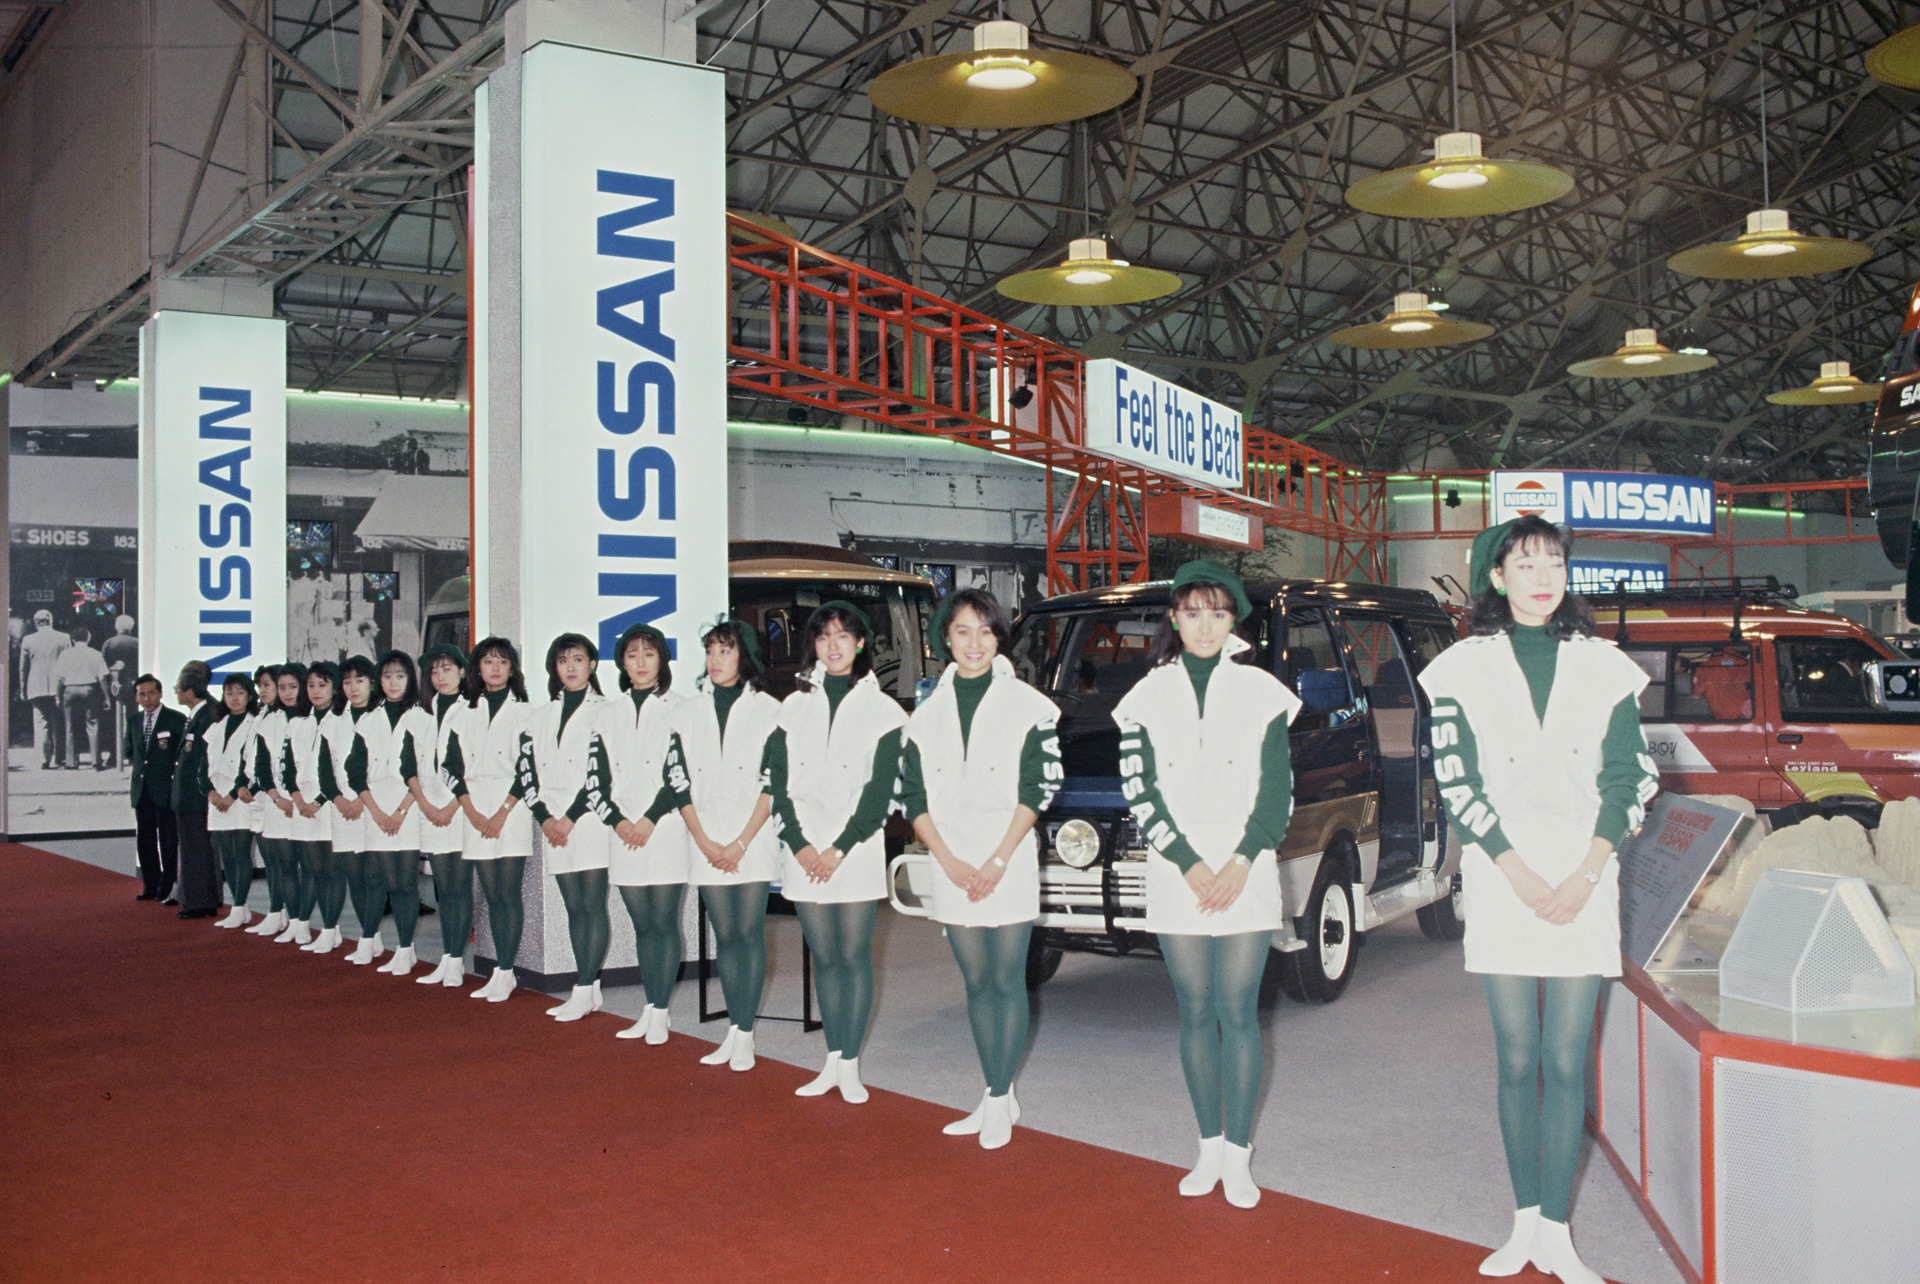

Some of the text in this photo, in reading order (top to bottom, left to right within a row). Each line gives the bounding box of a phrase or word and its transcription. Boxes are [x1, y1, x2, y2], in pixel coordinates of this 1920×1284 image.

[596, 168, 678, 661] NISSAN
[1115, 365, 1240, 482] Feel the Beat
[27, 528, 90, 546] SHOES
[114, 535, 137, 549] 182
[198, 385, 252, 686] NISSAN
[1504, 492, 1557, 506] NISSAN
[1571, 480, 1712, 525] NISSAN
